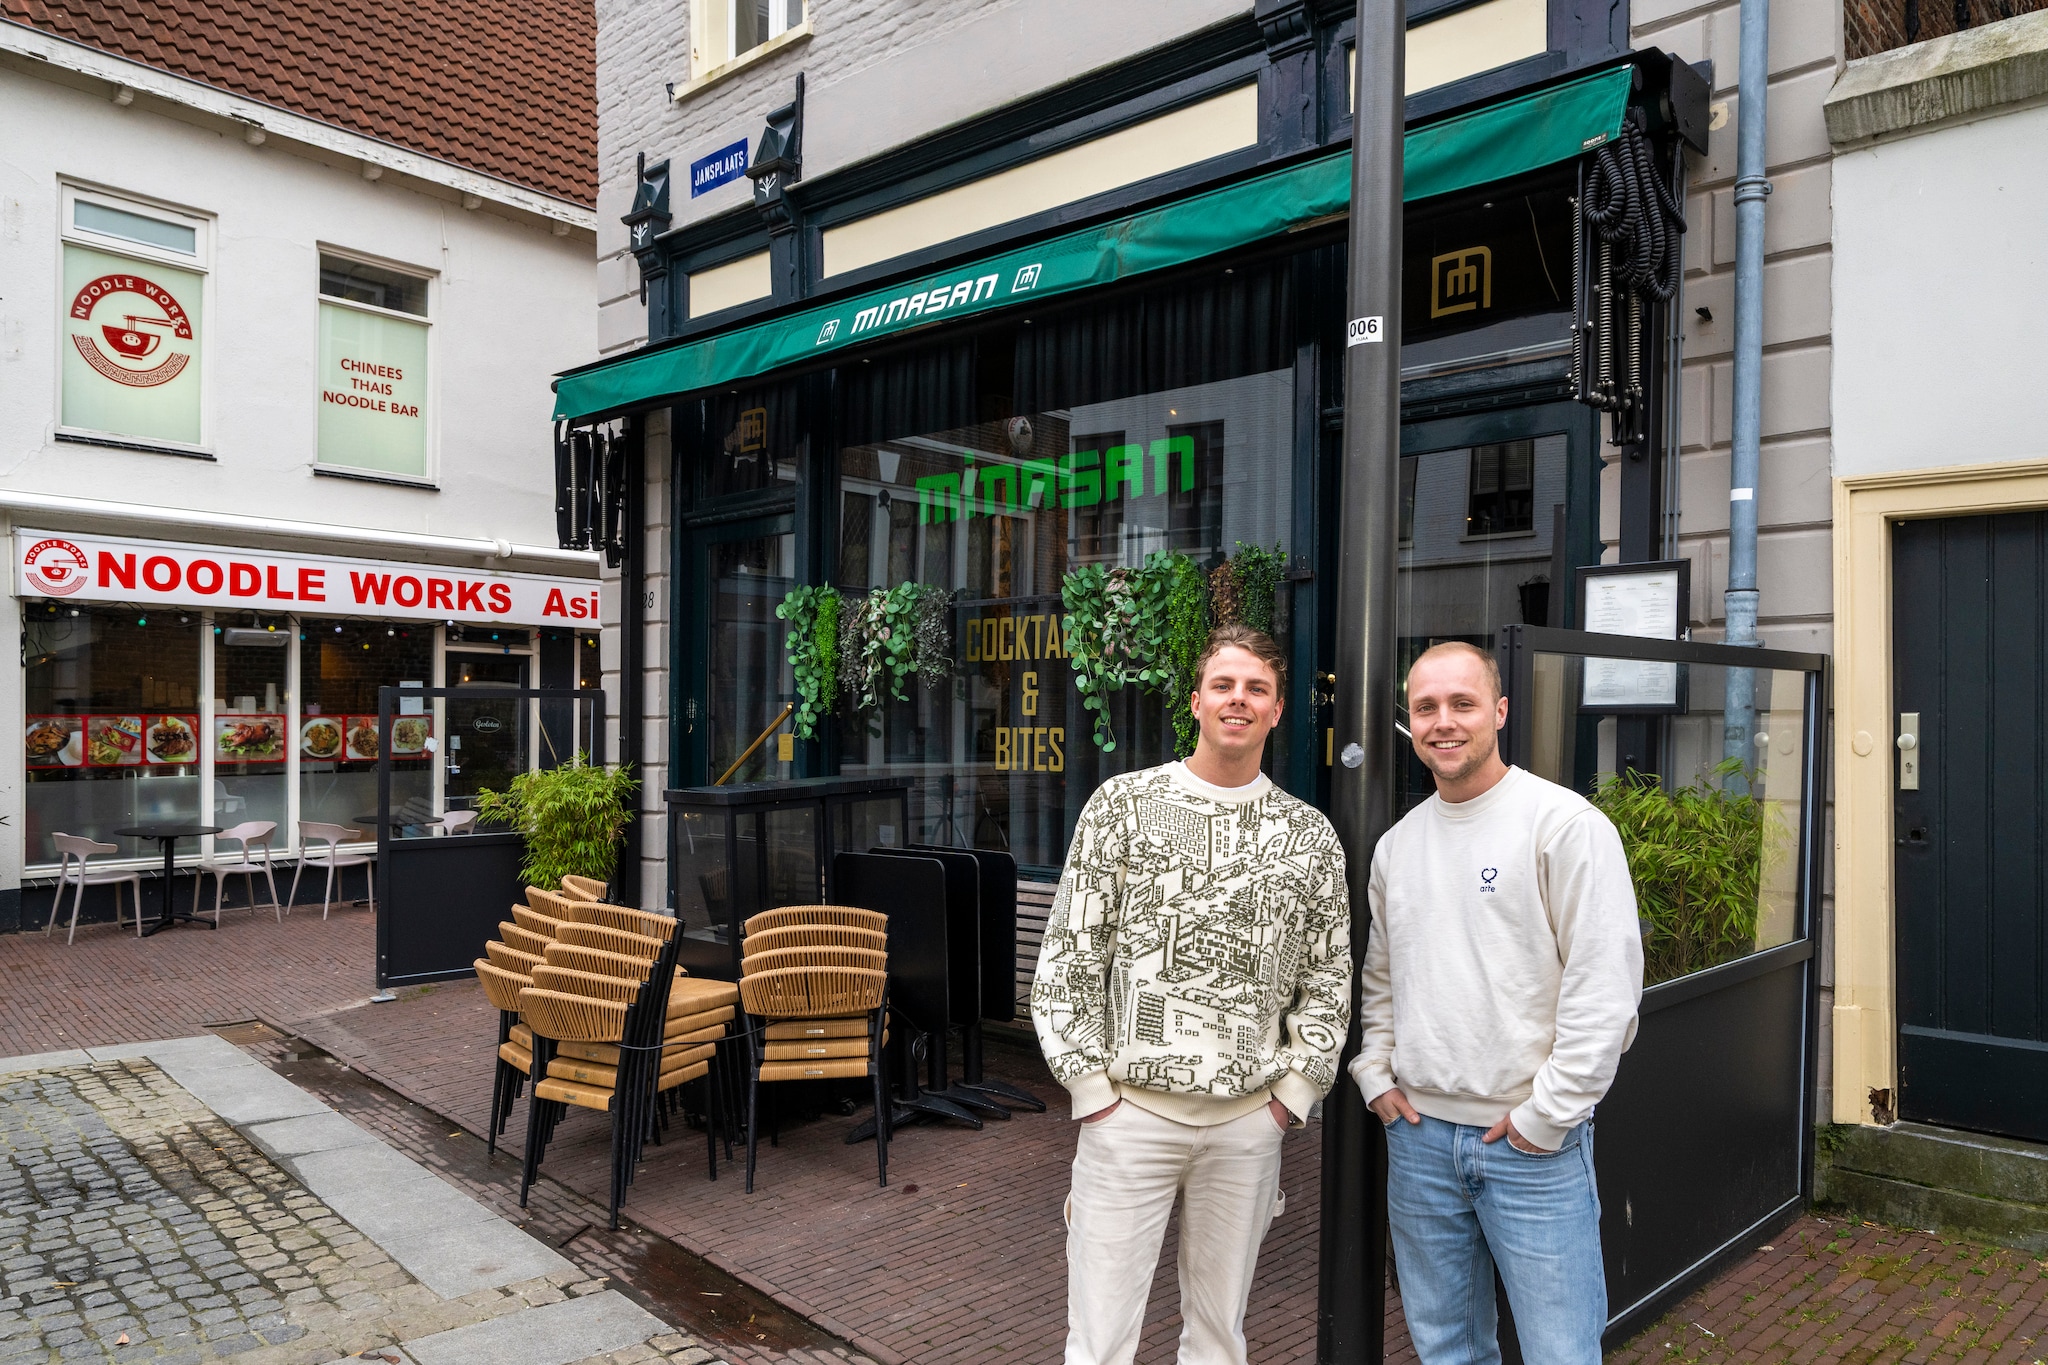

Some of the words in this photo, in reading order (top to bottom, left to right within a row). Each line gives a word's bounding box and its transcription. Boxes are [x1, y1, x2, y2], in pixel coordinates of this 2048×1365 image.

[694, 150, 744, 187] JANSPLAATS
[75, 278, 134, 317] NOODLE
[145, 284, 189, 335] WORKS
[850, 273, 999, 334] MINASAN
[1350, 319, 1377, 337] 006
[340, 358, 403, 380] CHINEES
[350, 377, 393, 396] THAIS
[323, 390, 386, 412] NOODLE
[391, 402, 418, 418] BAR
[915, 435, 1195, 527] MINASAN
[27, 541, 58, 564] NOODLE
[62, 542, 87, 567] WORKS
[98, 551, 326, 602] NOODLE
[350, 571, 512, 614] WORKS
[542, 588, 598, 619] Asi
[1021, 671, 1040, 716] &
[995, 727, 1065, 772] BITES
